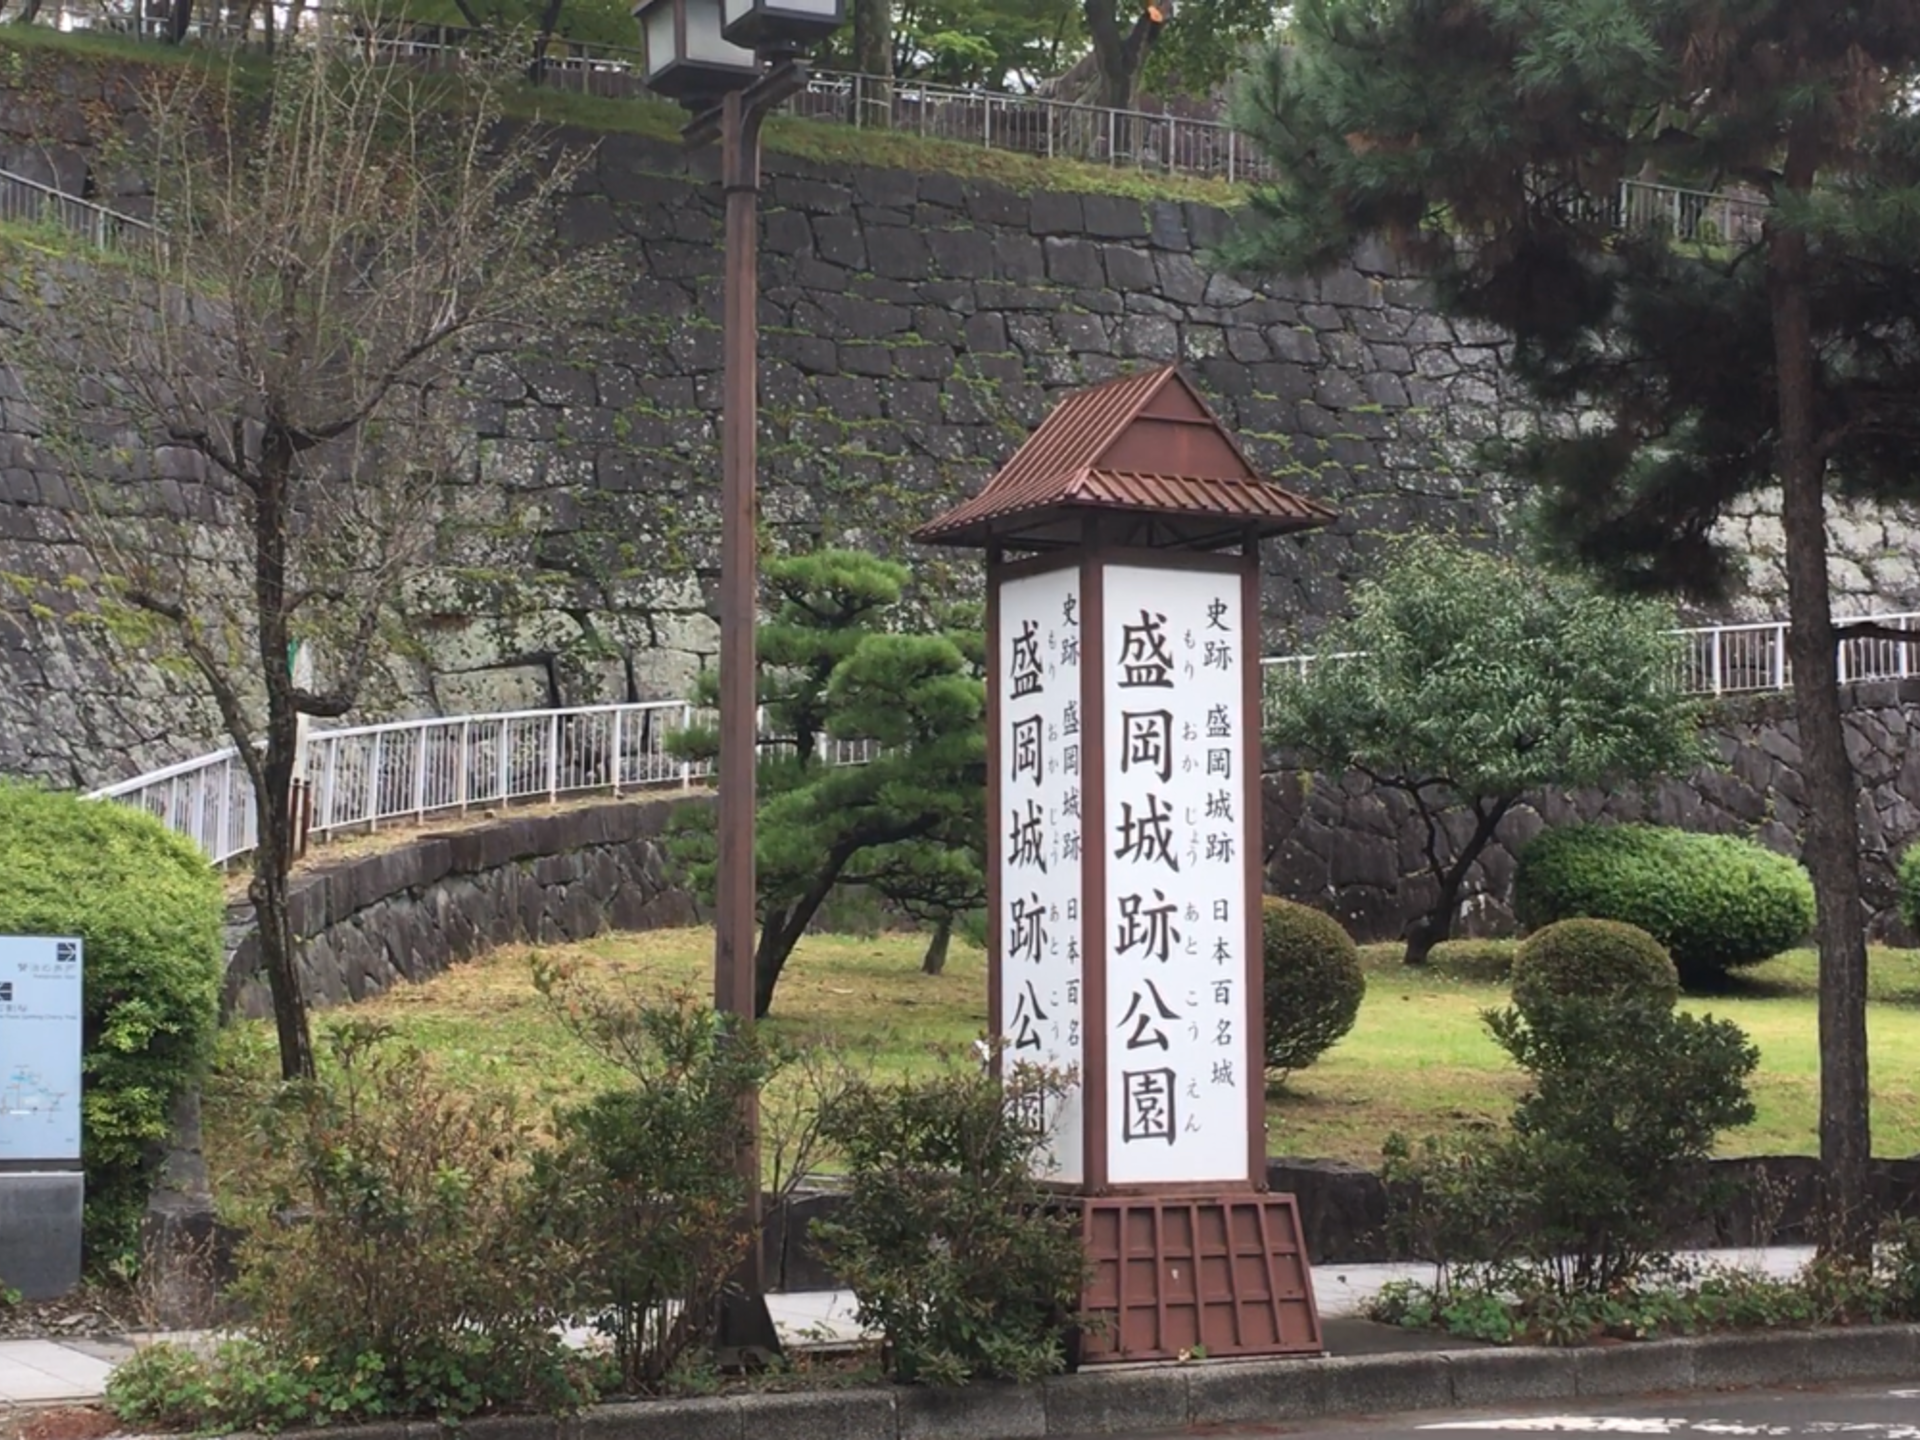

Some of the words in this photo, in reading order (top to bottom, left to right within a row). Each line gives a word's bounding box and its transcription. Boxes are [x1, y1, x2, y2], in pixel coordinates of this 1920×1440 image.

[1060, 593, 1080, 666] 史跡
[1203, 597, 1233, 671] 史跡
[1062, 700, 1081, 861] 盛岡城跡
[1205, 703, 1235, 863] 盛岡城跡
[1114, 609, 1182, 1146] 盛岡城跡公園
[1211, 898, 1235, 1087] 日本百名城
